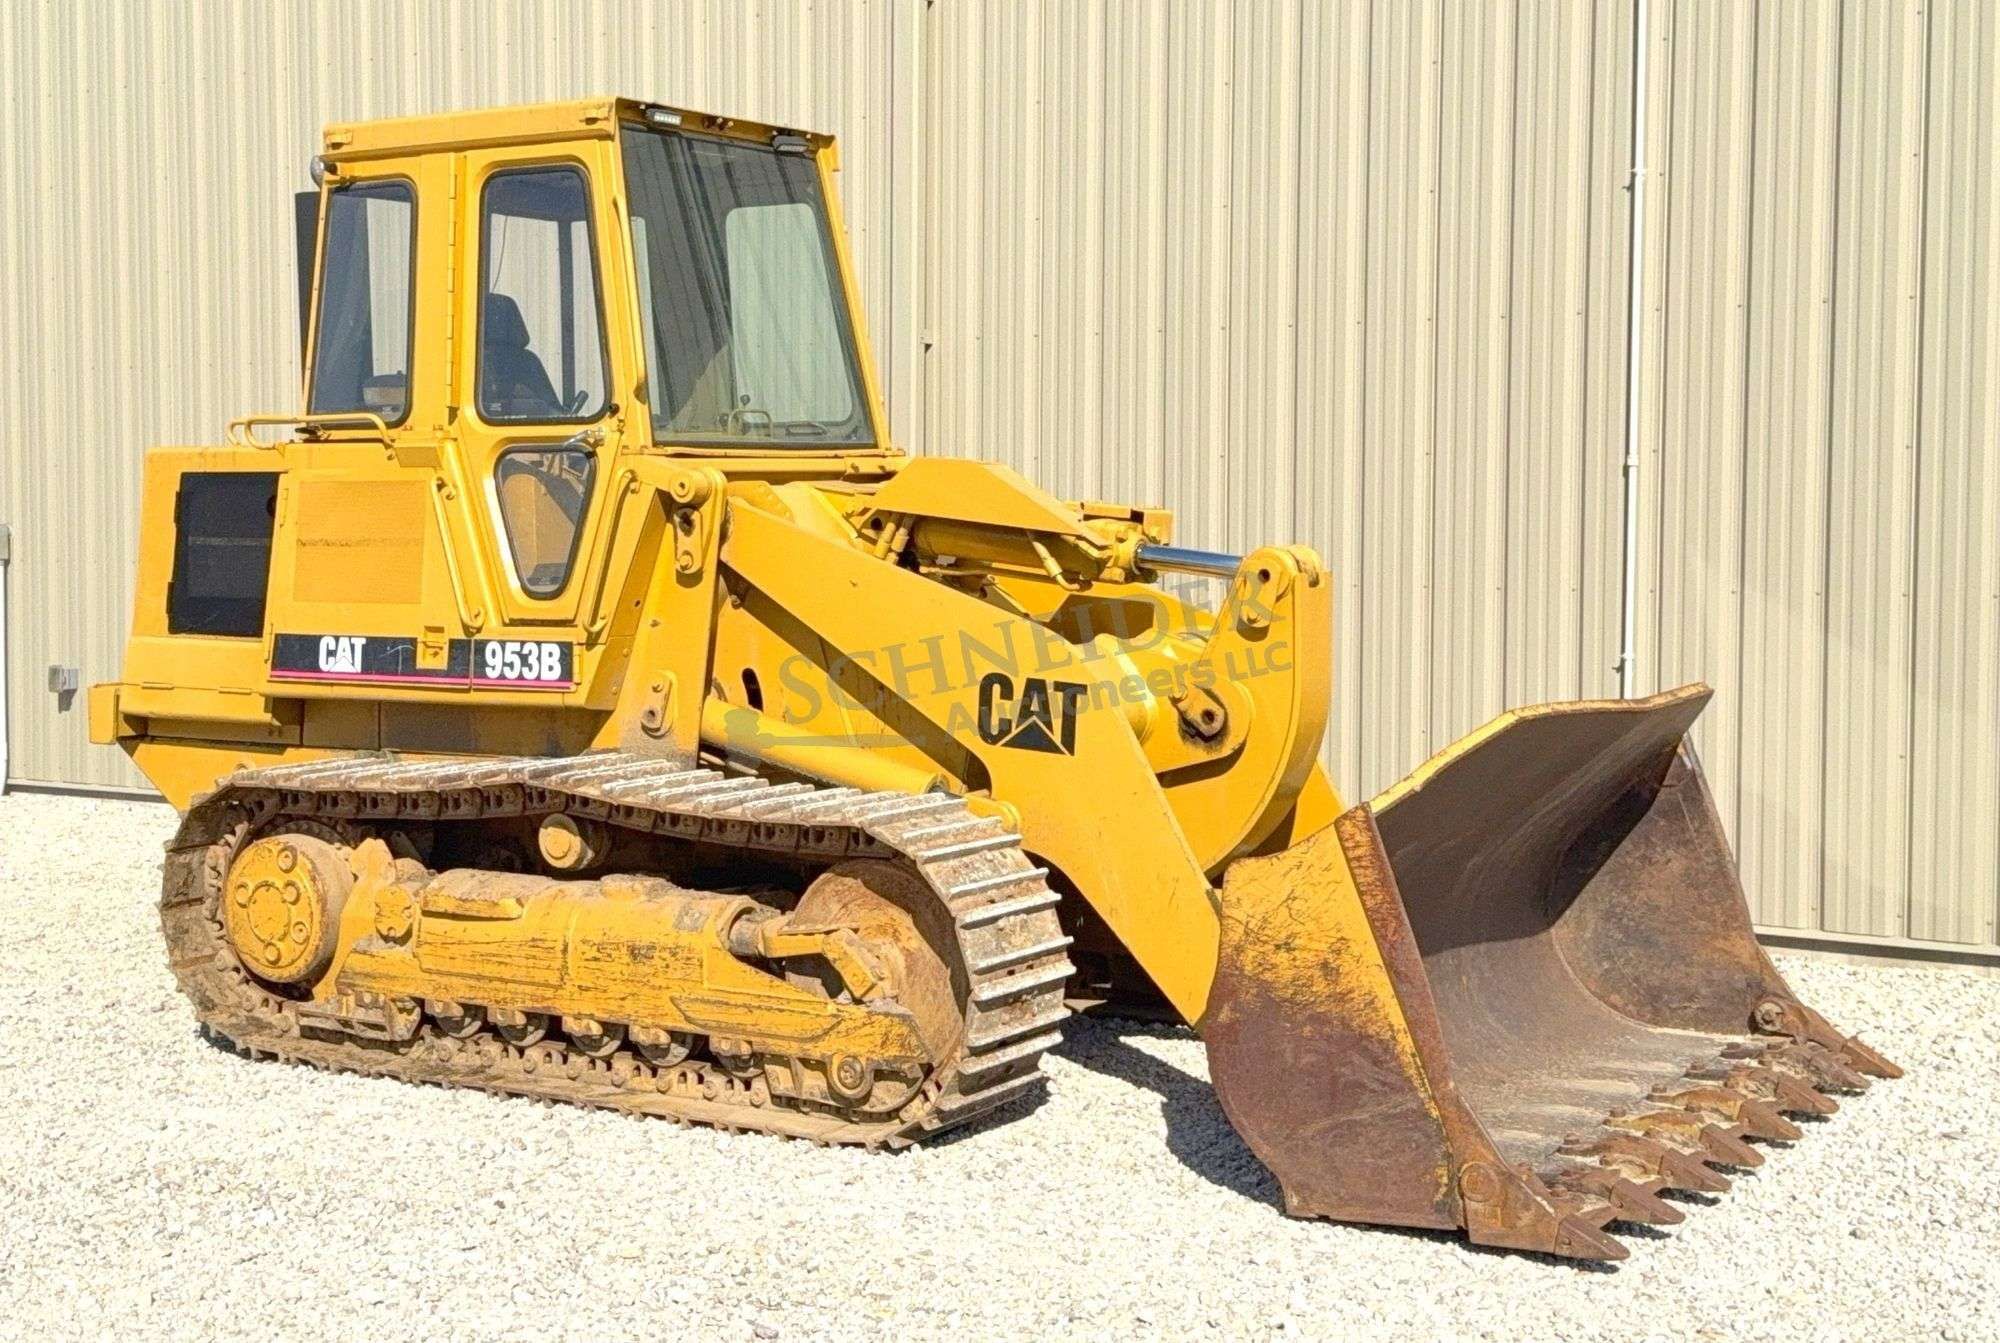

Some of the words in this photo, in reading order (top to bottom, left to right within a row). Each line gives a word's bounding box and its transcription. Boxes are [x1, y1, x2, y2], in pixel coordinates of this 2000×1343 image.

[318, 636, 367, 673] CAT
[485, 641, 562, 680] 953B
[978, 672, 1088, 756] CAT
